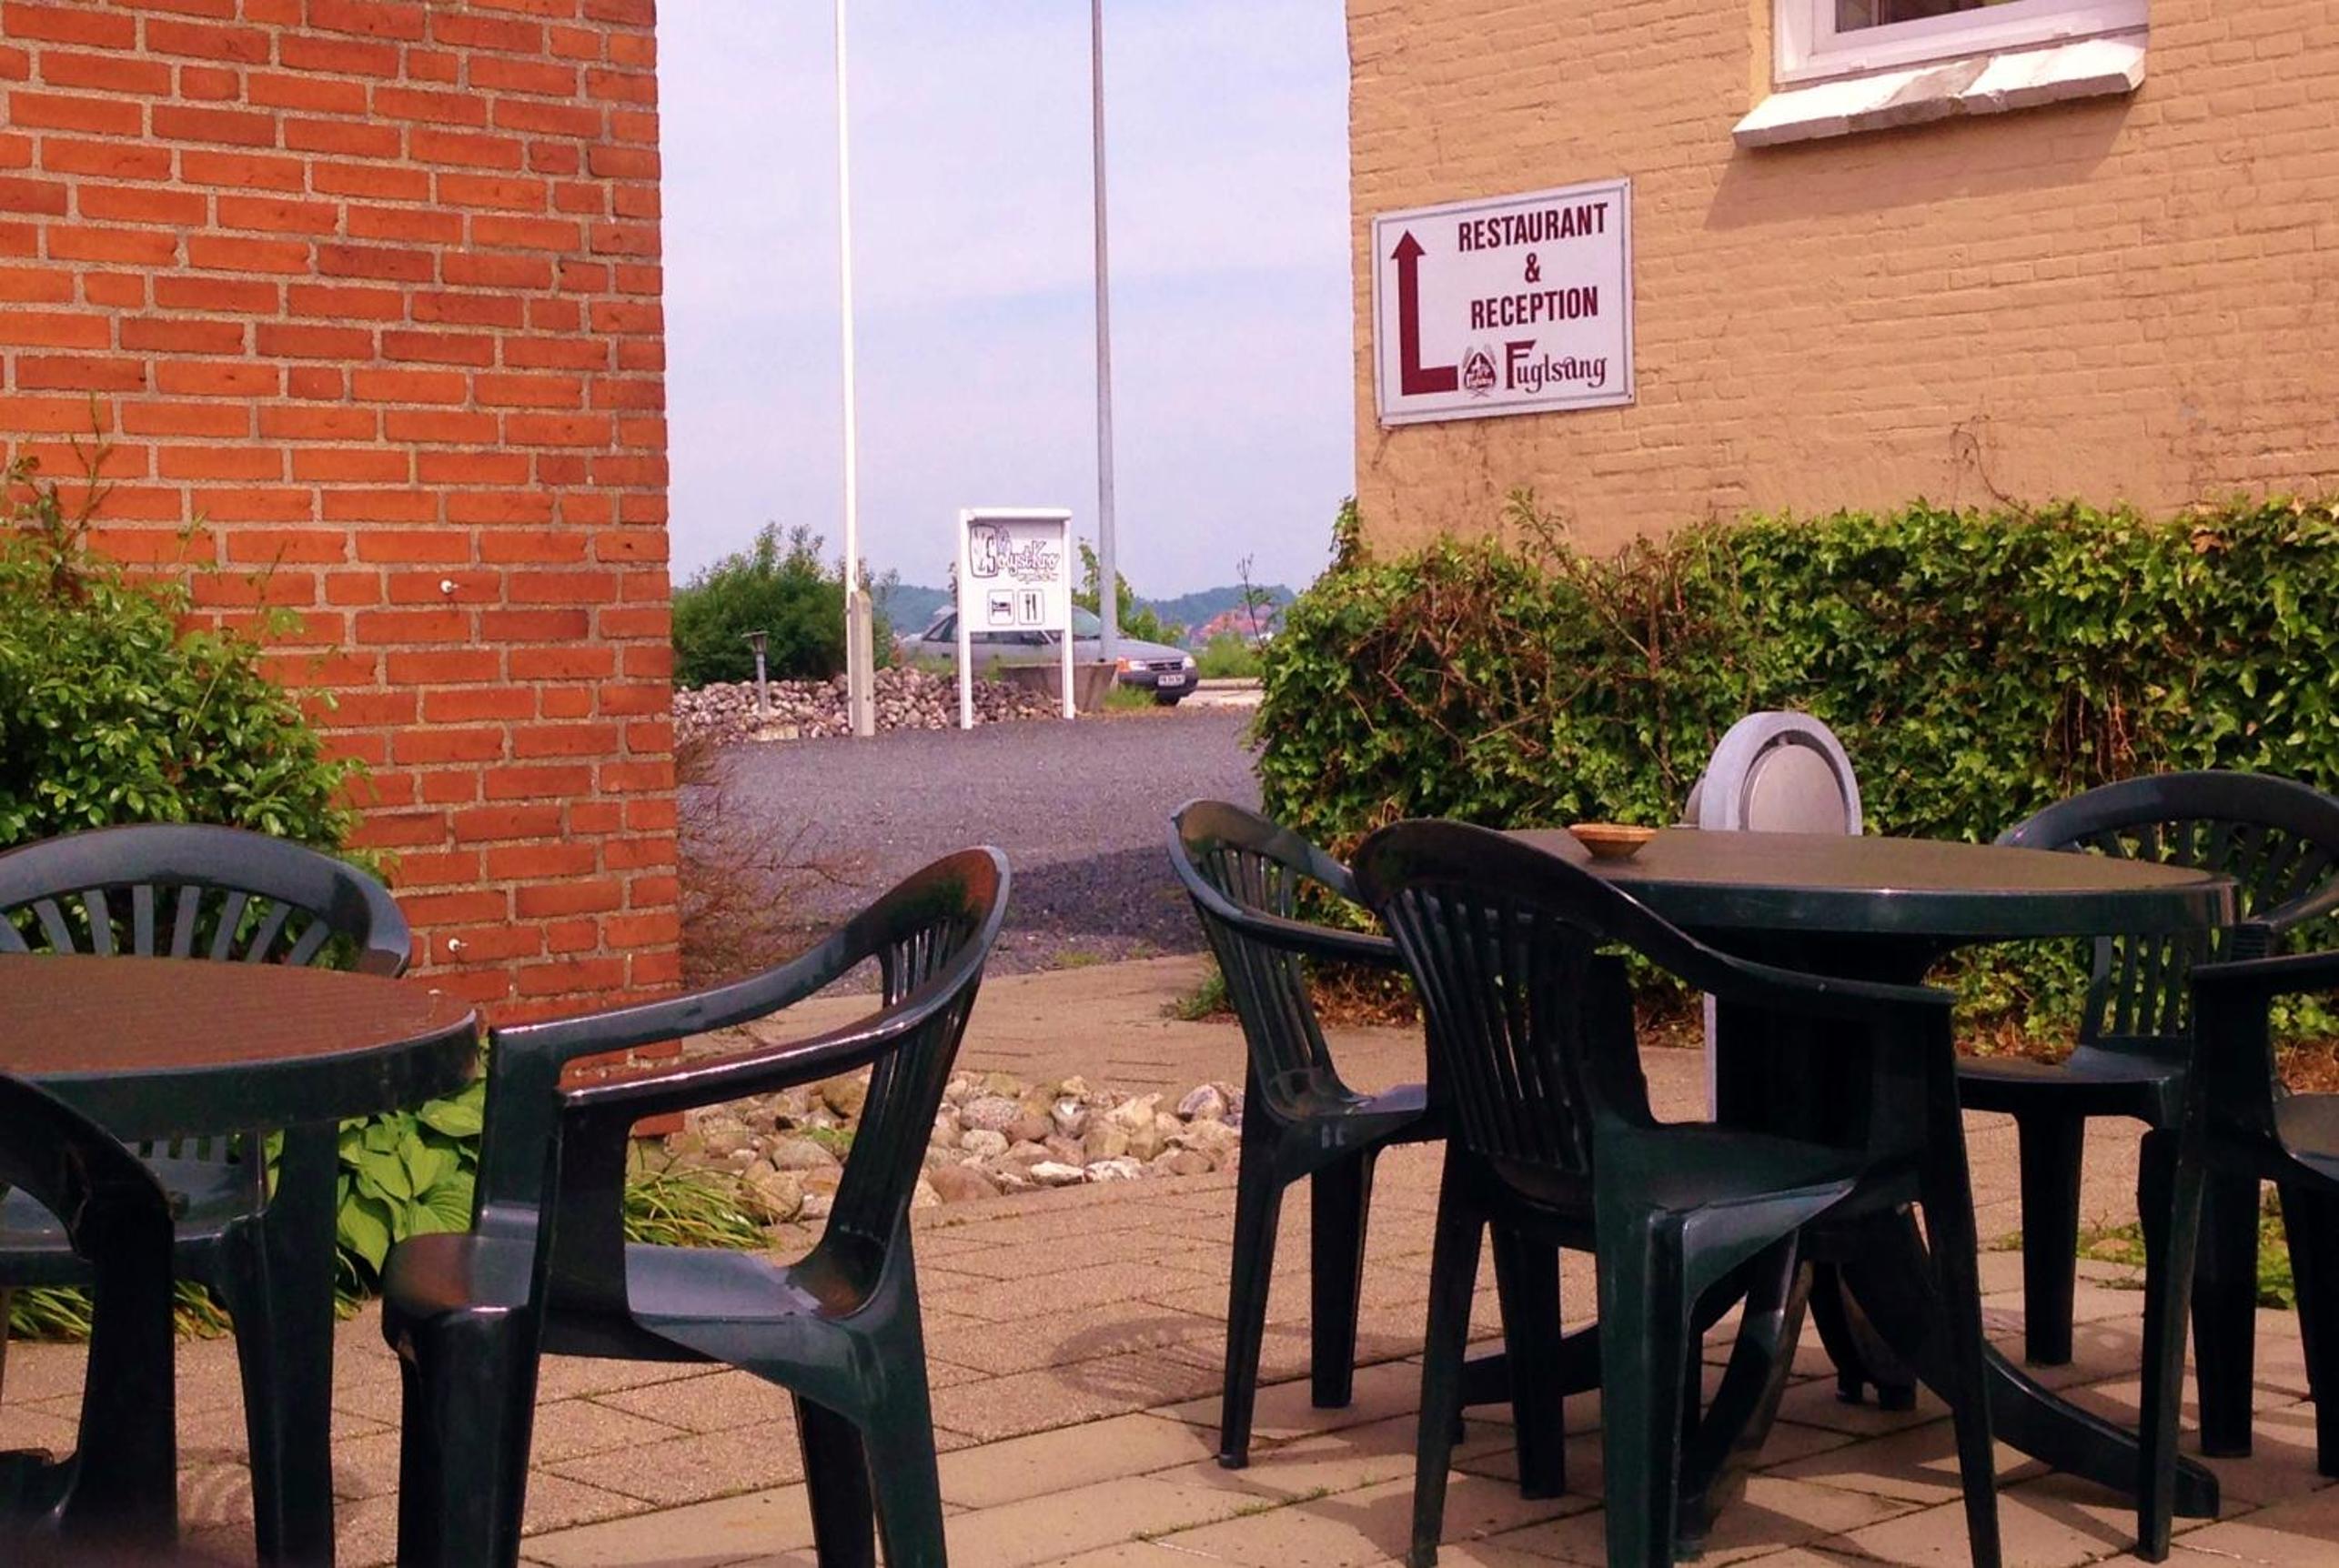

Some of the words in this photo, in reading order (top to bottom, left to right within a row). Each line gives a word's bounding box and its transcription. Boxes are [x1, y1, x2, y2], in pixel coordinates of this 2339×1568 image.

[1458, 202, 1608, 253] RESTAURANT
[1524, 252, 1541, 283] &
[1471, 286, 1598, 330] RECEPTION
[1505, 339, 1608, 393] Fuglsang
